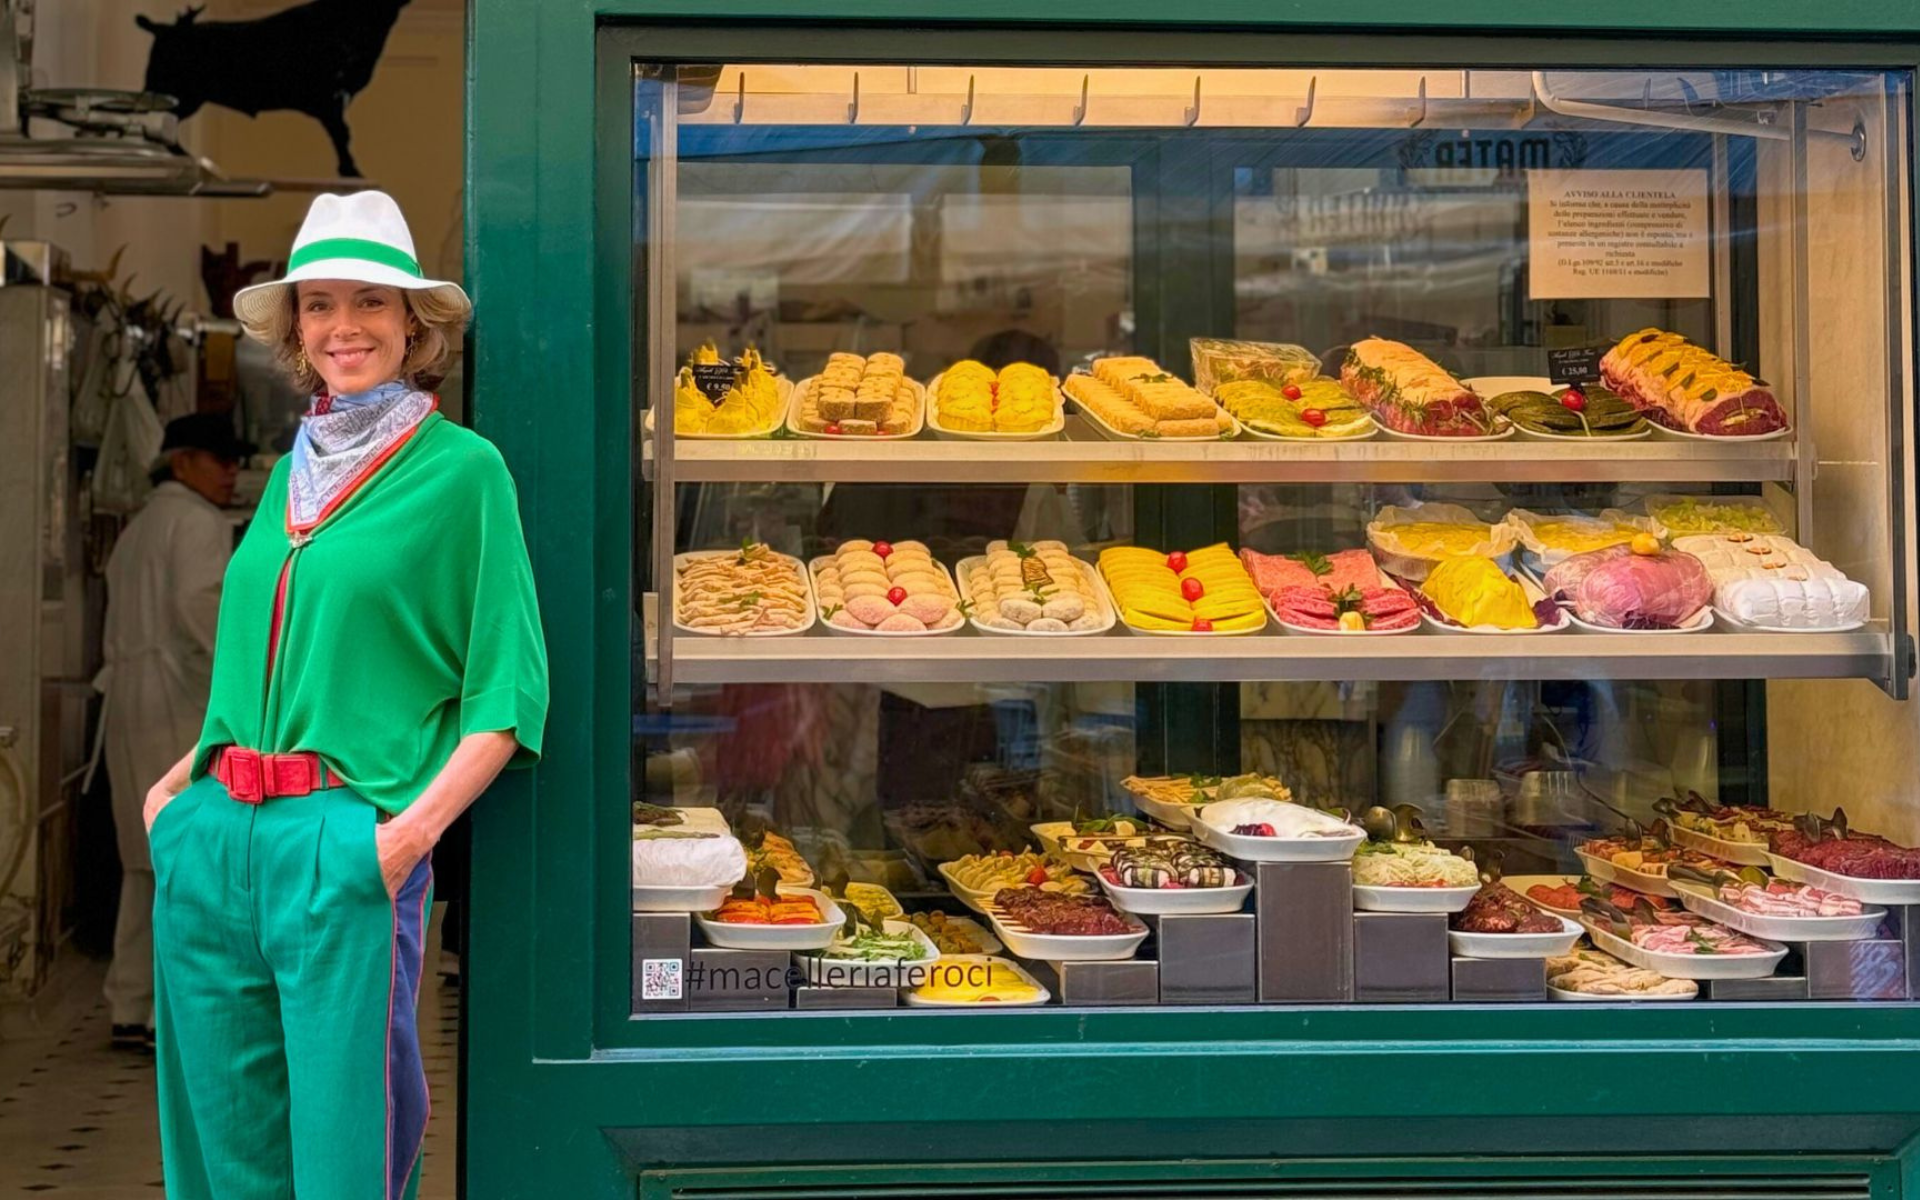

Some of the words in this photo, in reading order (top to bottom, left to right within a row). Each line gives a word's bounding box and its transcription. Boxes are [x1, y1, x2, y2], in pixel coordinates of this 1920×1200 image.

[1564, 190, 1599, 198] AVVISO
[1601, 190, 1624, 198] ALLA
[1625, 191, 1676, 199] CLIENTELA
[685, 957, 992, 991] #macelleriaferoci
